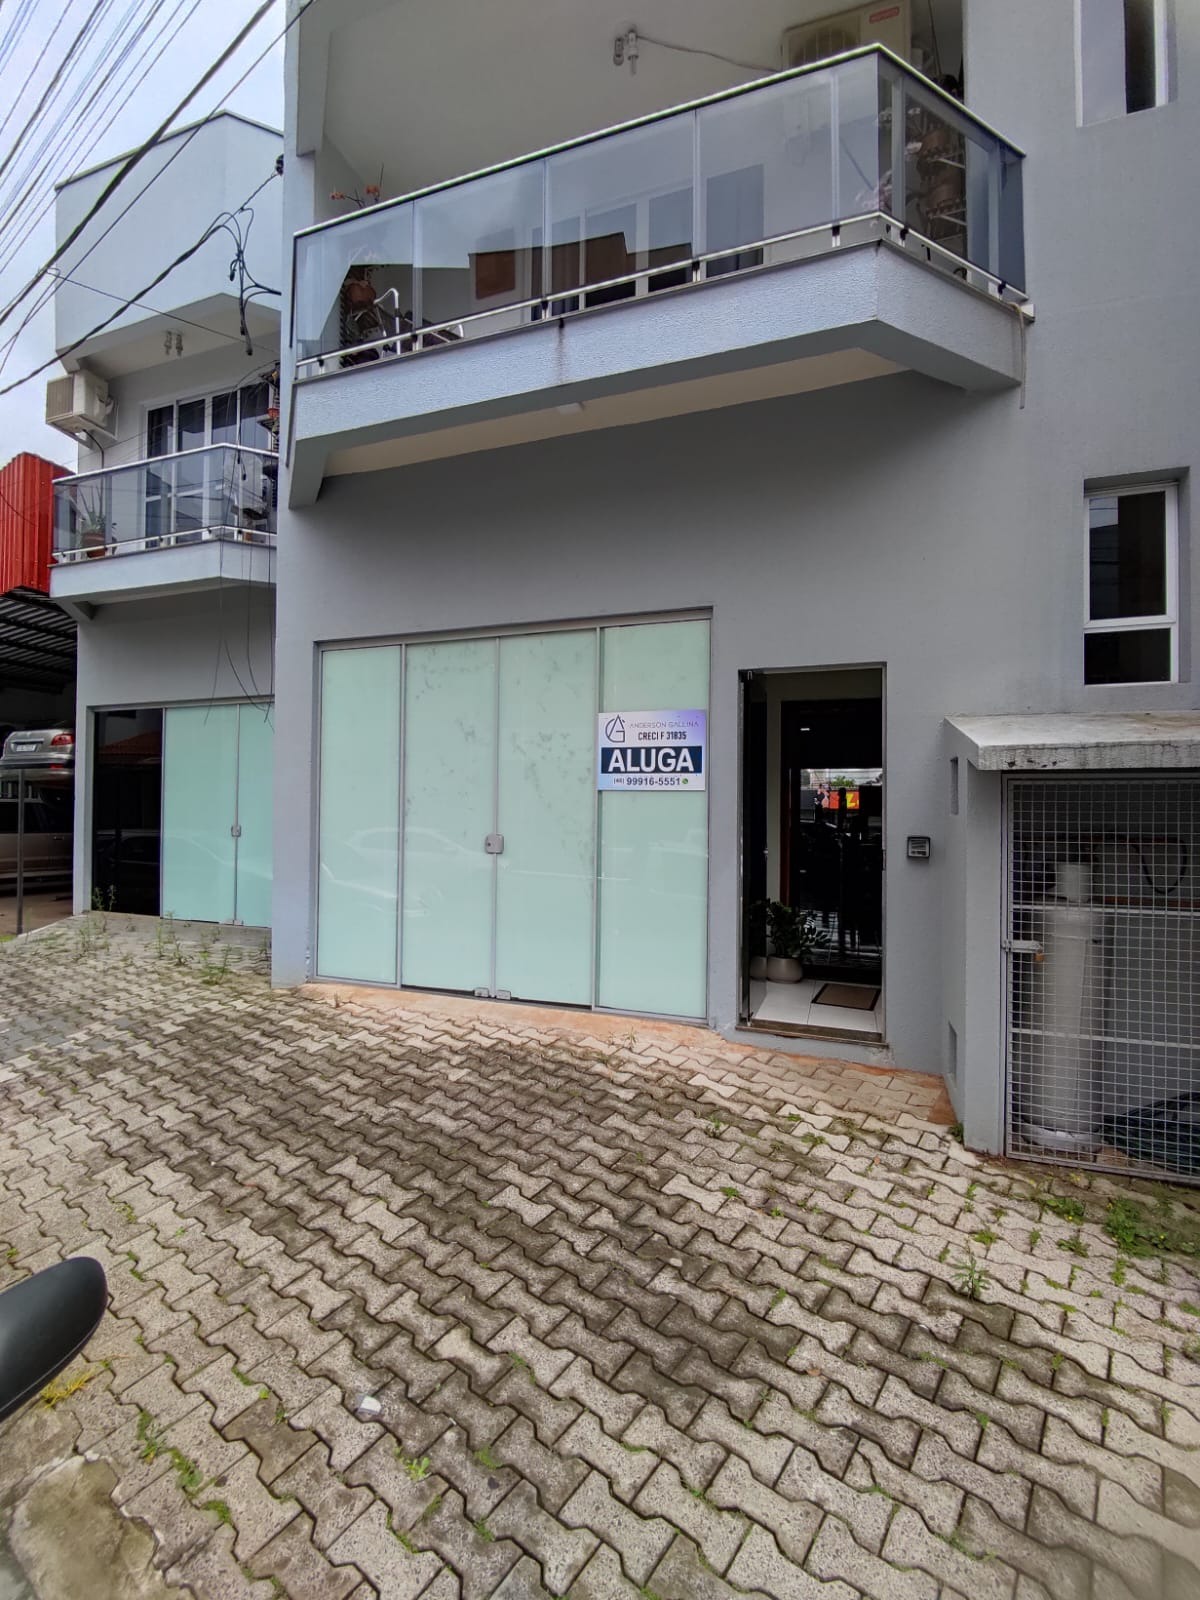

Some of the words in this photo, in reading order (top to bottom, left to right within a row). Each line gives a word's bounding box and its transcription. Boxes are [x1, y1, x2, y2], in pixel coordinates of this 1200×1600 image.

[629, 721, 667, 729] ANDERSON
[638, 731, 659, 741] CRECI
[660, 731, 665, 740] F
[607, 747, 695, 773] ALUGA
[626, 777, 681, 786] 99916-5551
